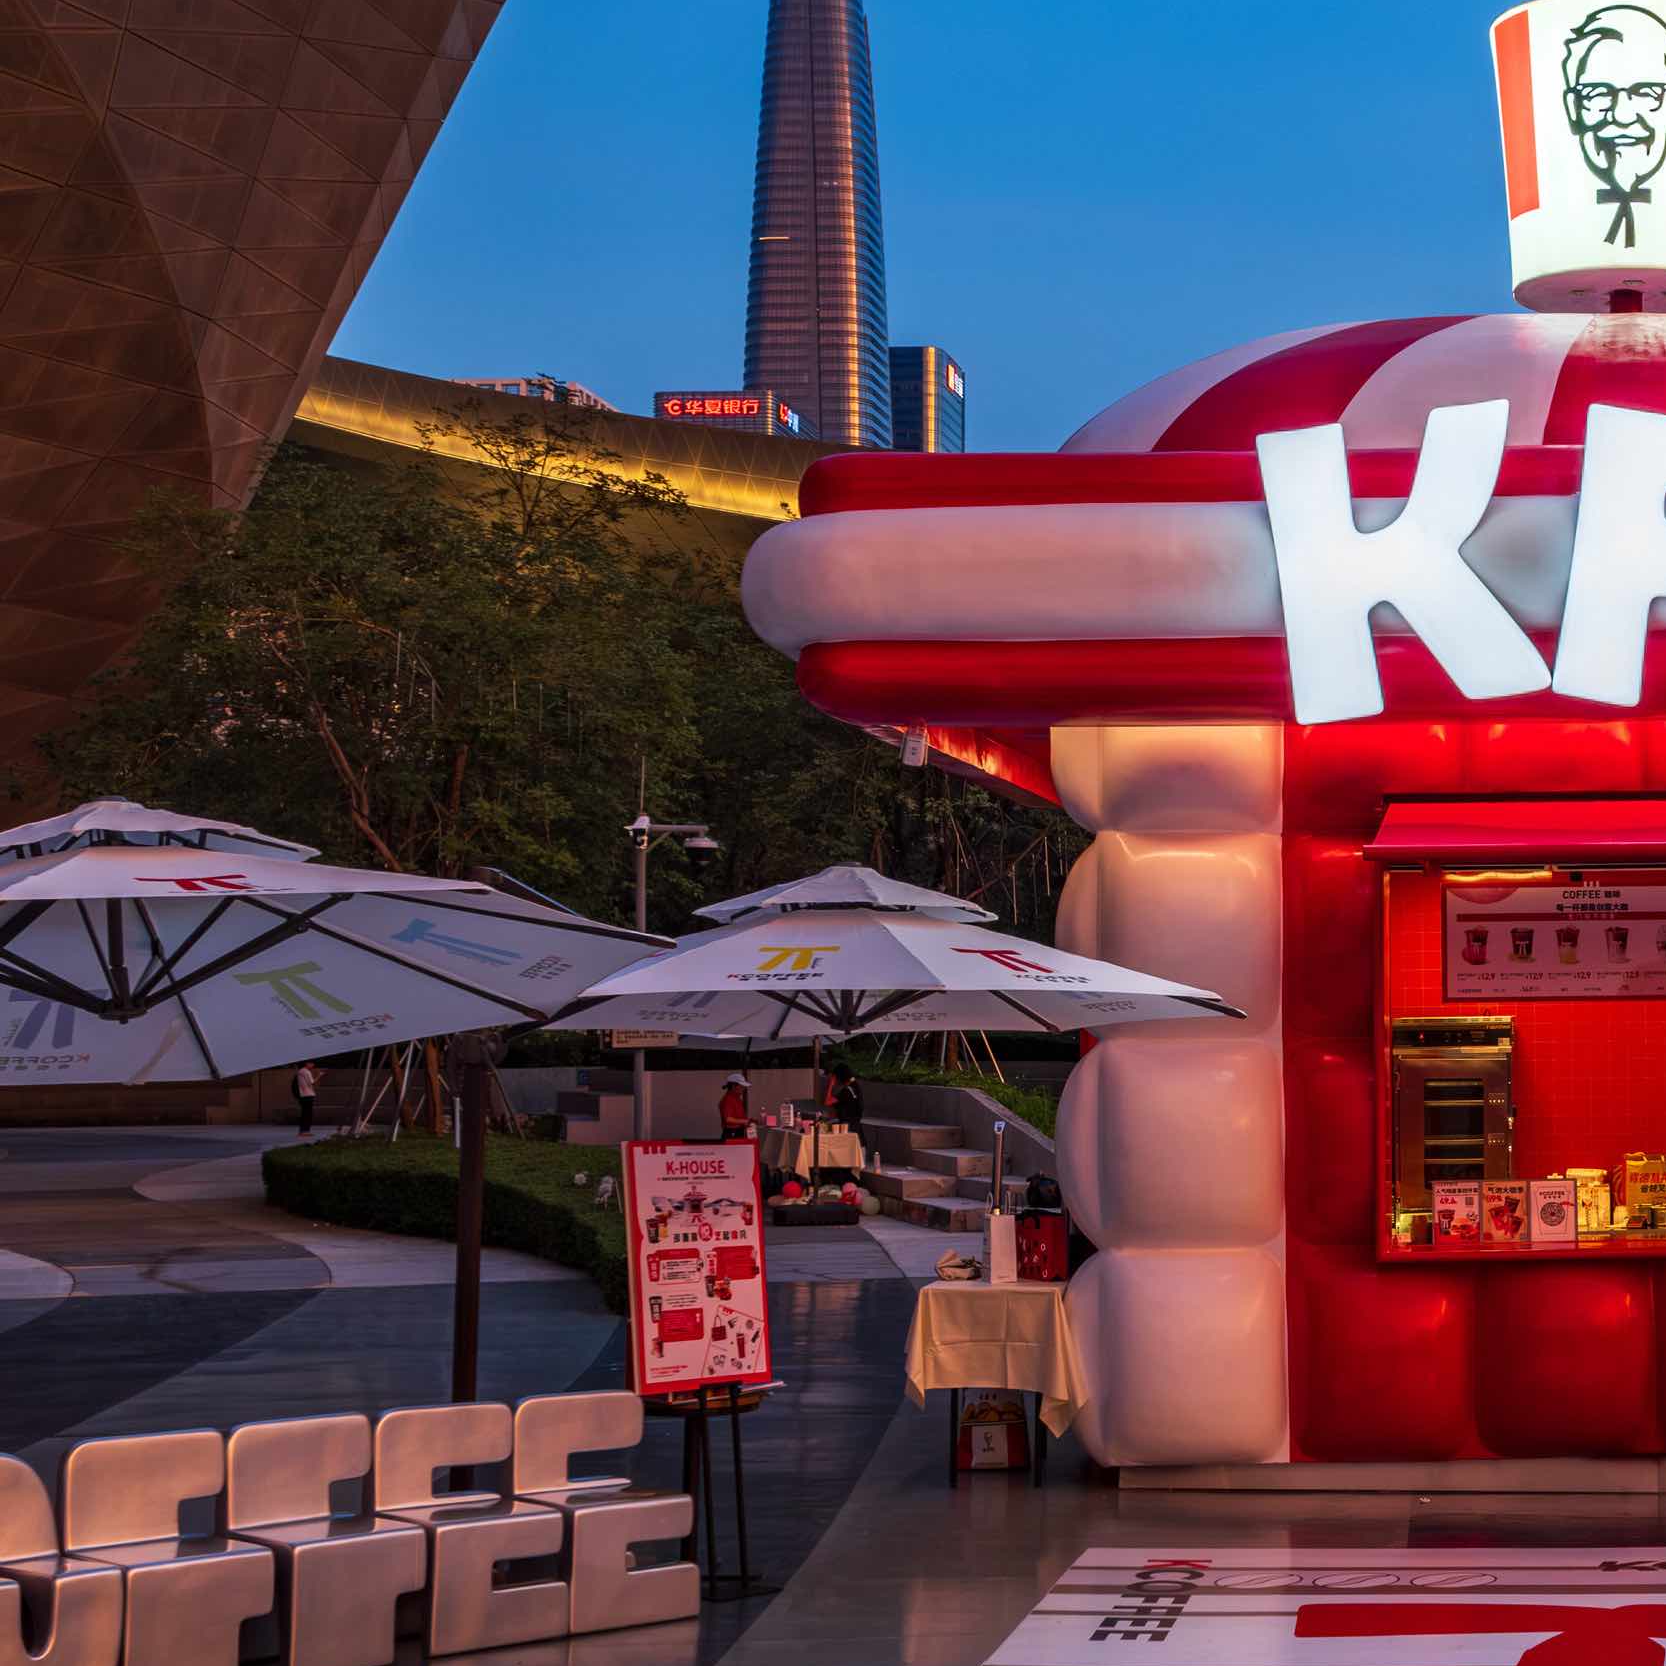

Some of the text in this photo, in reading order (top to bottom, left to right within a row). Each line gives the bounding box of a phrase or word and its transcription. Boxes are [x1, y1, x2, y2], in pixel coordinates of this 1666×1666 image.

[685, 399, 760, 416] 华夏银行
[1562, 890, 1601, 899] COFFEE
[665, 1160, 726, 1175] K-HOUSE
[1089, 1559, 1213, 1642] KCOFFEE
